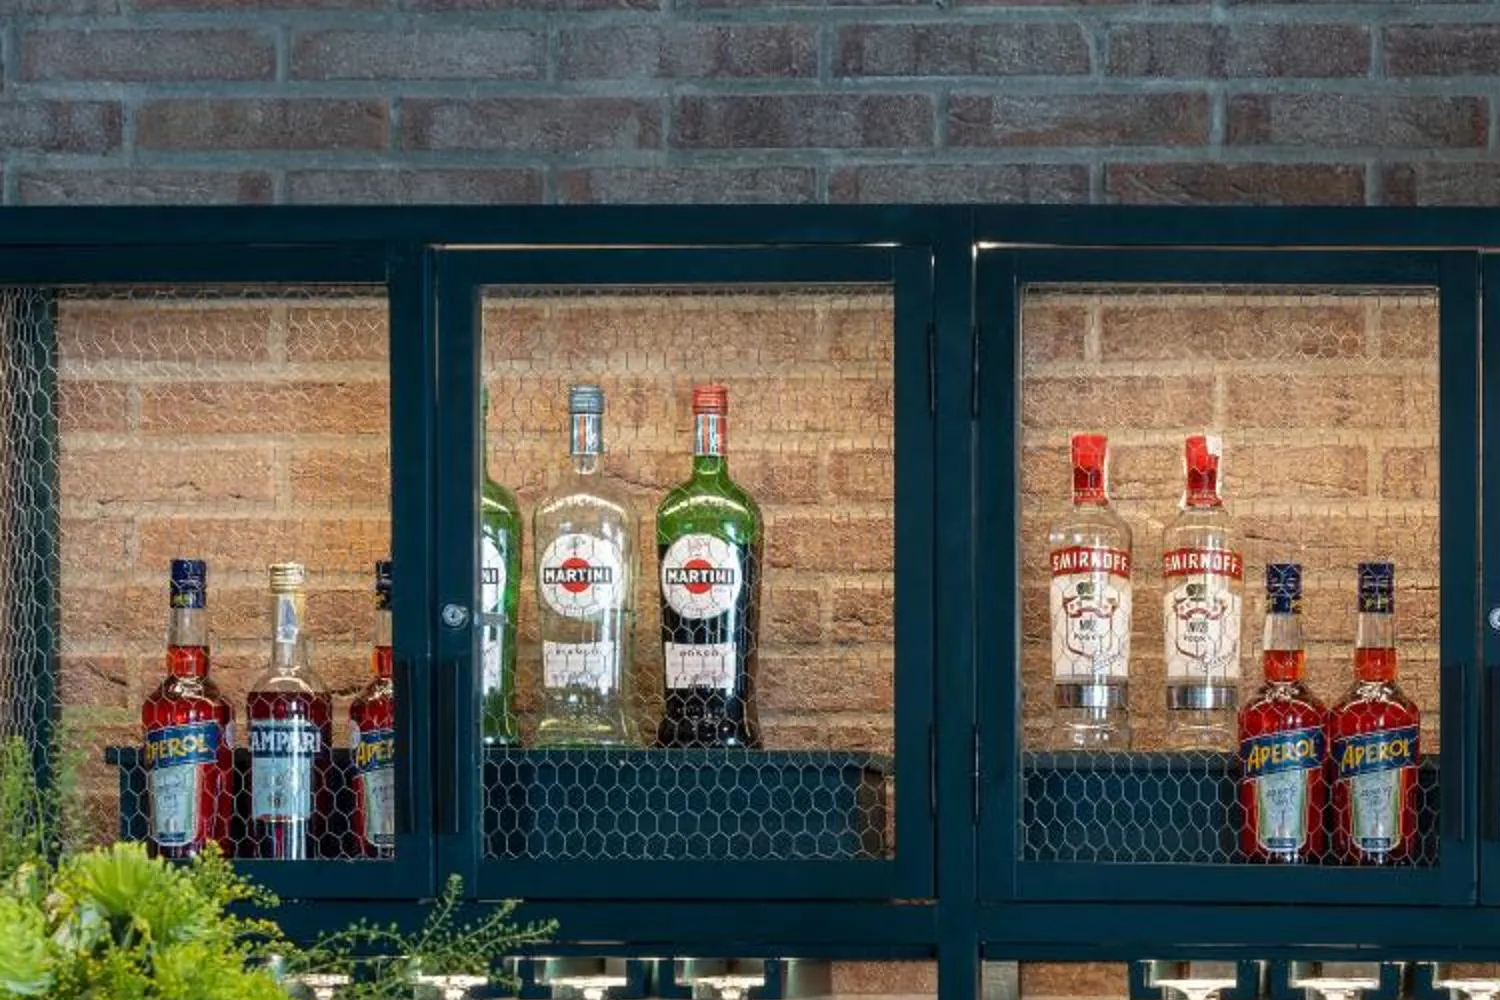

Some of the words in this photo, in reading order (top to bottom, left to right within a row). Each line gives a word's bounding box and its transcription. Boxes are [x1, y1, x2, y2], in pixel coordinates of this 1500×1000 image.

[1053, 551, 1128, 571] SMIRNOFF
[1165, 552, 1238, 572] SMIRNOFF
[545, 568, 611, 584] MARTINI
[667, 568, 733, 584] MARTINI
[248, 731, 322, 752] AMPARI
[1247, 739, 1317, 771] APEROL
[1341, 738, 1410, 771] APEROL
